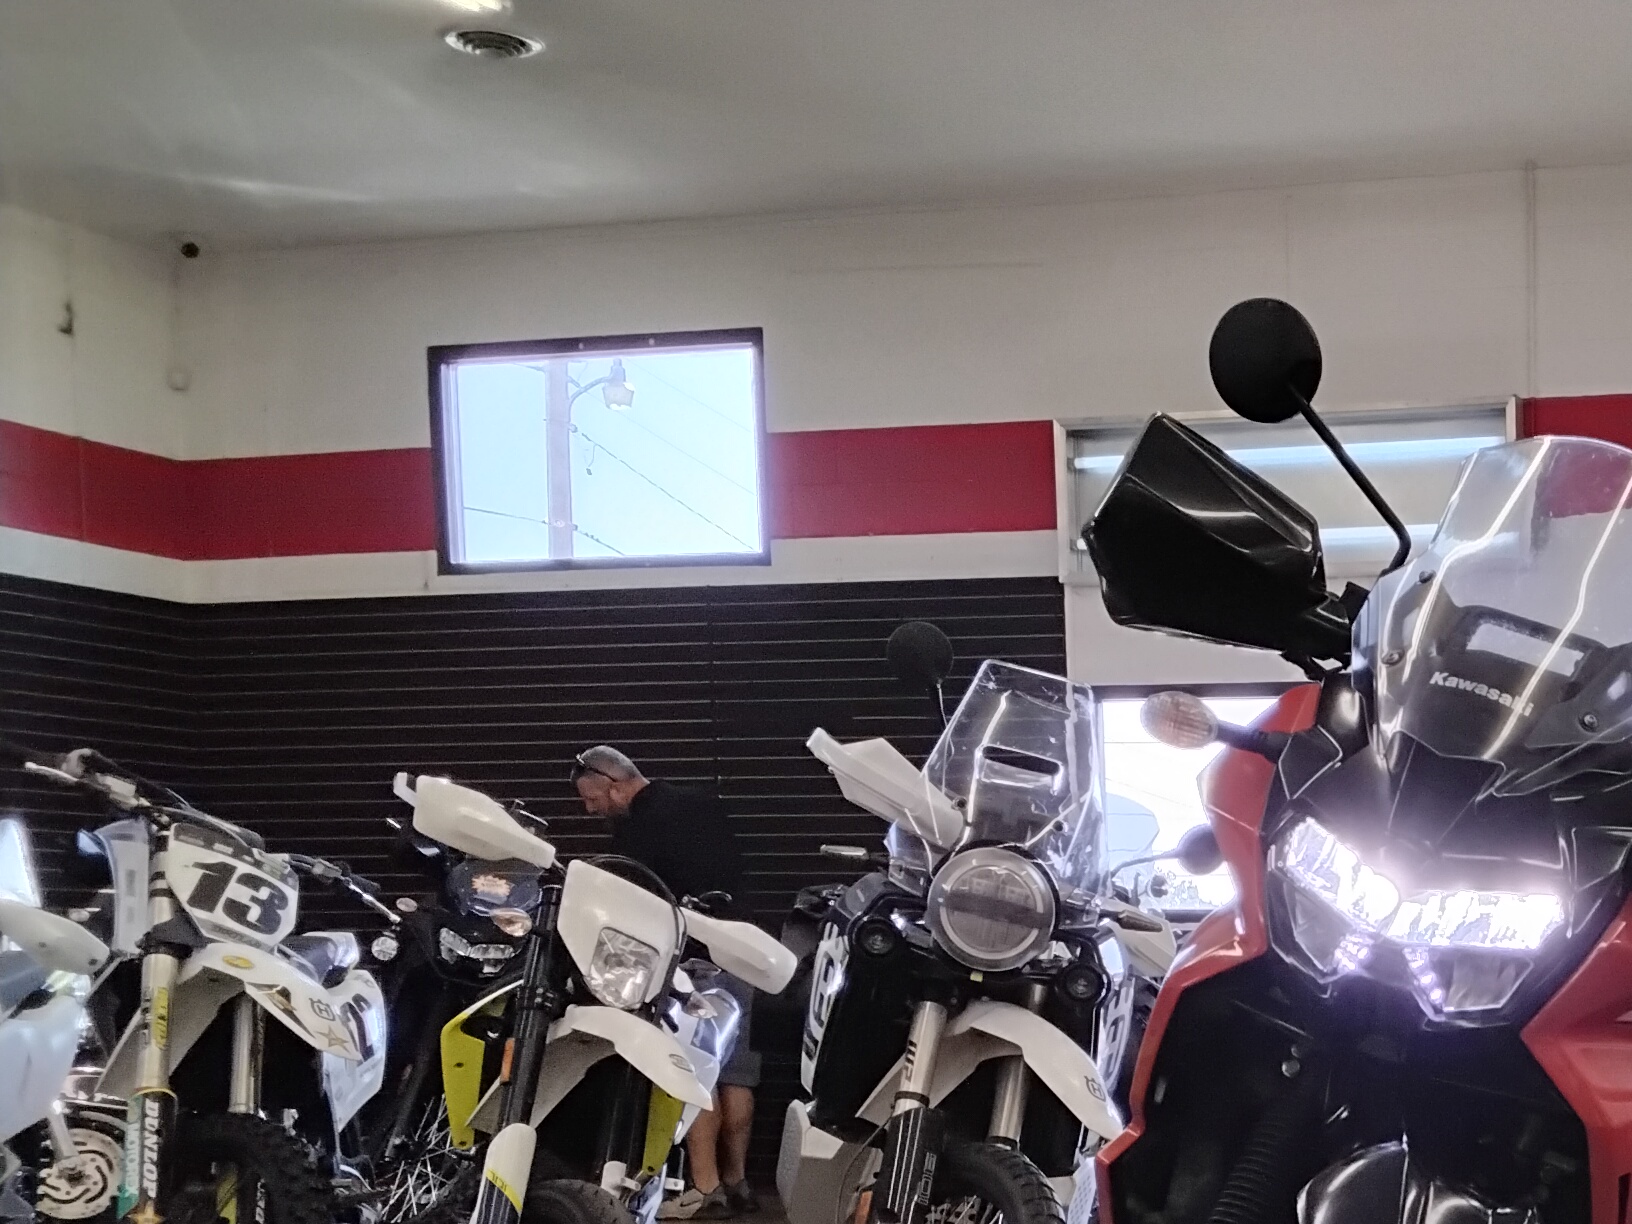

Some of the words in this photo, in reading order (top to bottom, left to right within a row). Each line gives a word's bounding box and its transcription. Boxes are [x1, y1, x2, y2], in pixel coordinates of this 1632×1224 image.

[1429, 671, 1534, 717] Kawasaki
[187, 861, 289, 935] 13
[143, 1098, 159, 1199] DUNLOP
